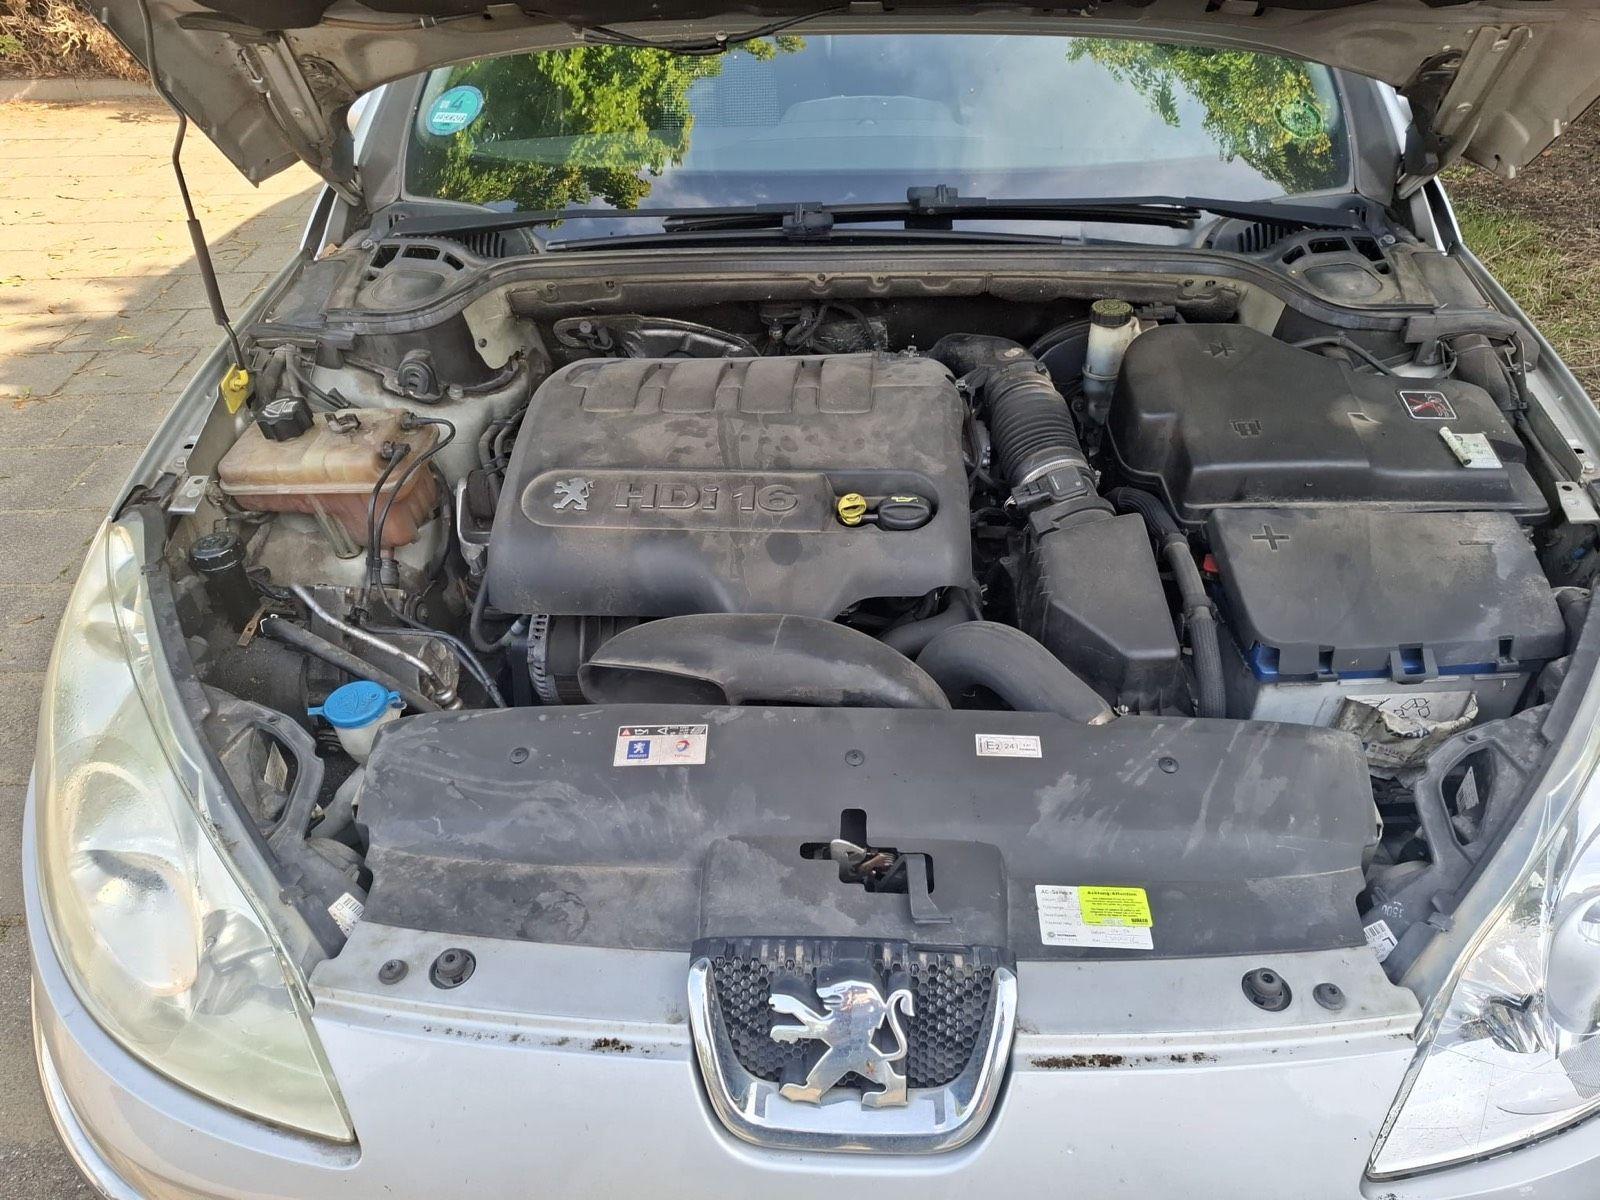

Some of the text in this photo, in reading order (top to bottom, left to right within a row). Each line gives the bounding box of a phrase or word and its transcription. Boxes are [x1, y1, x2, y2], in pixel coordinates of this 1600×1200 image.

[449, 91, 466, 110] 4
[614, 482, 799, 512] HDi 16
